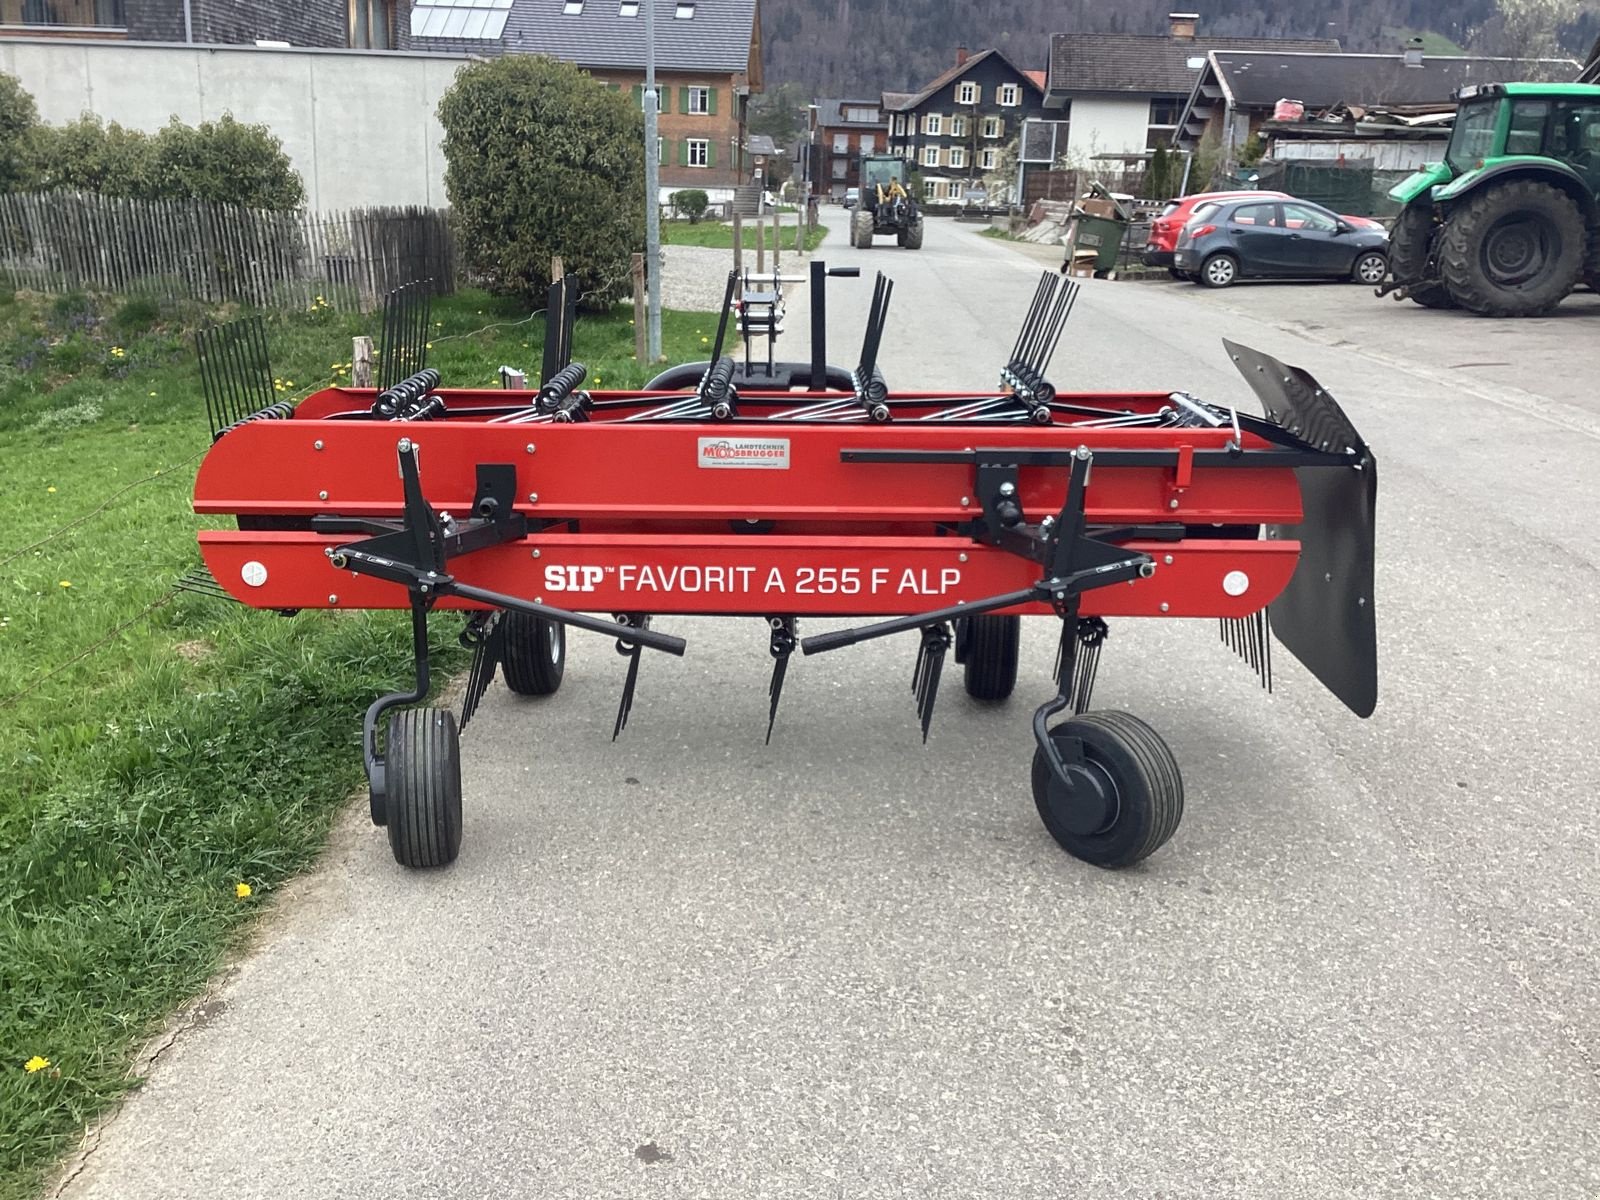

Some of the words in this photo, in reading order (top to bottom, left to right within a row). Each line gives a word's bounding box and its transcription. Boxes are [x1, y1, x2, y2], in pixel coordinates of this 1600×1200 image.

[703, 446, 785, 458] MOOSBRUGGER
[619, 564, 757, 593] FAVORIT
[764, 566, 786, 594] A
[795, 567, 861, 594] 255
[871, 568, 890, 594] F
[897, 568, 961, 595] ALP
